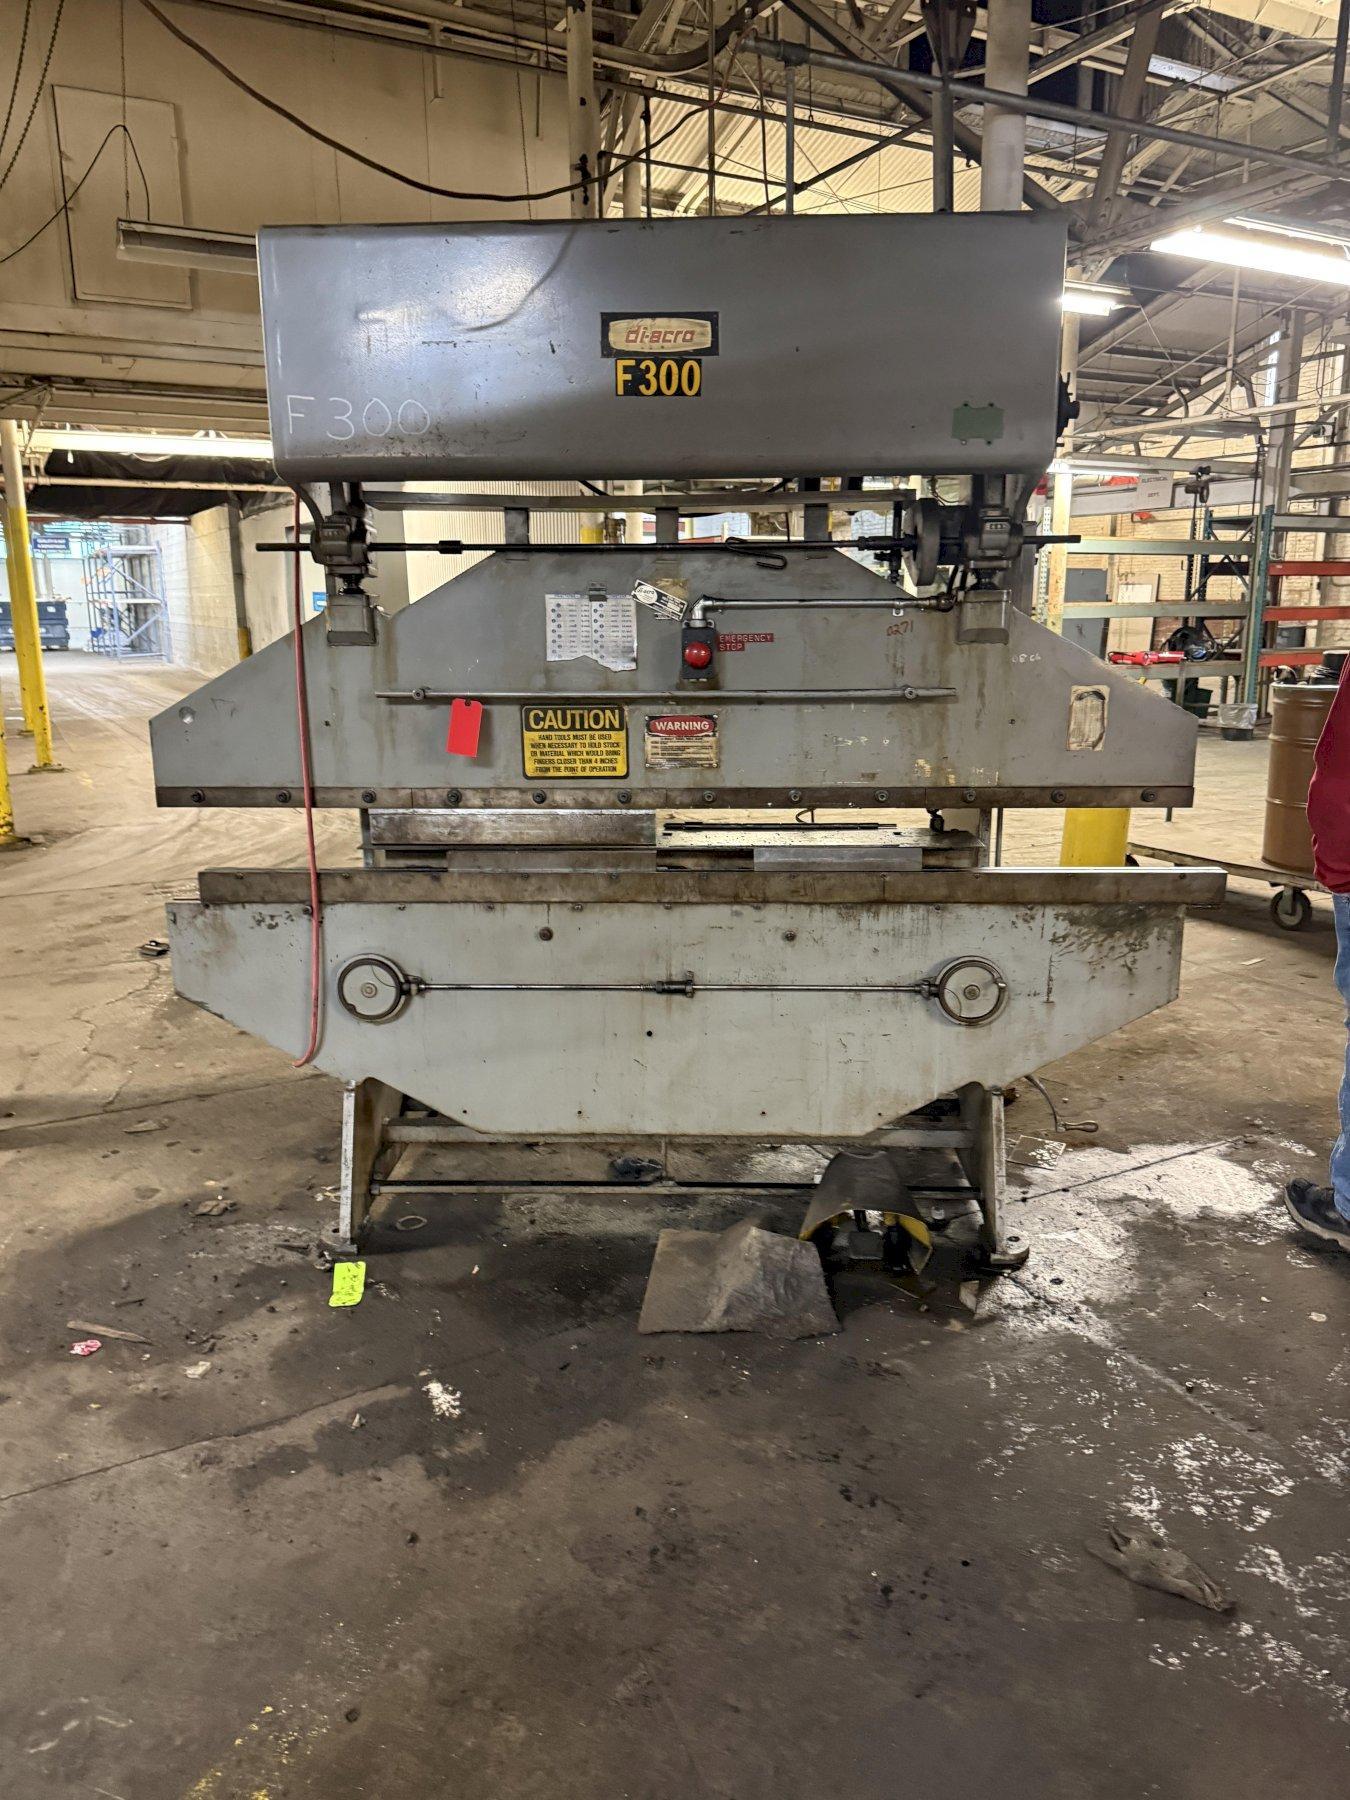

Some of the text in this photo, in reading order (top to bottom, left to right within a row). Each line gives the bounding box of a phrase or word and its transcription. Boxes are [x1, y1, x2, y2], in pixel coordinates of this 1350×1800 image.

[625, 326, 695, 343] di-acro
[617, 360, 700, 396] F300
[720, 634, 772, 642] EMERGENCY
[720, 643, 743, 651] STOP
[528, 709, 620, 730] CAUTION
[655, 722, 710, 730] WARNING
